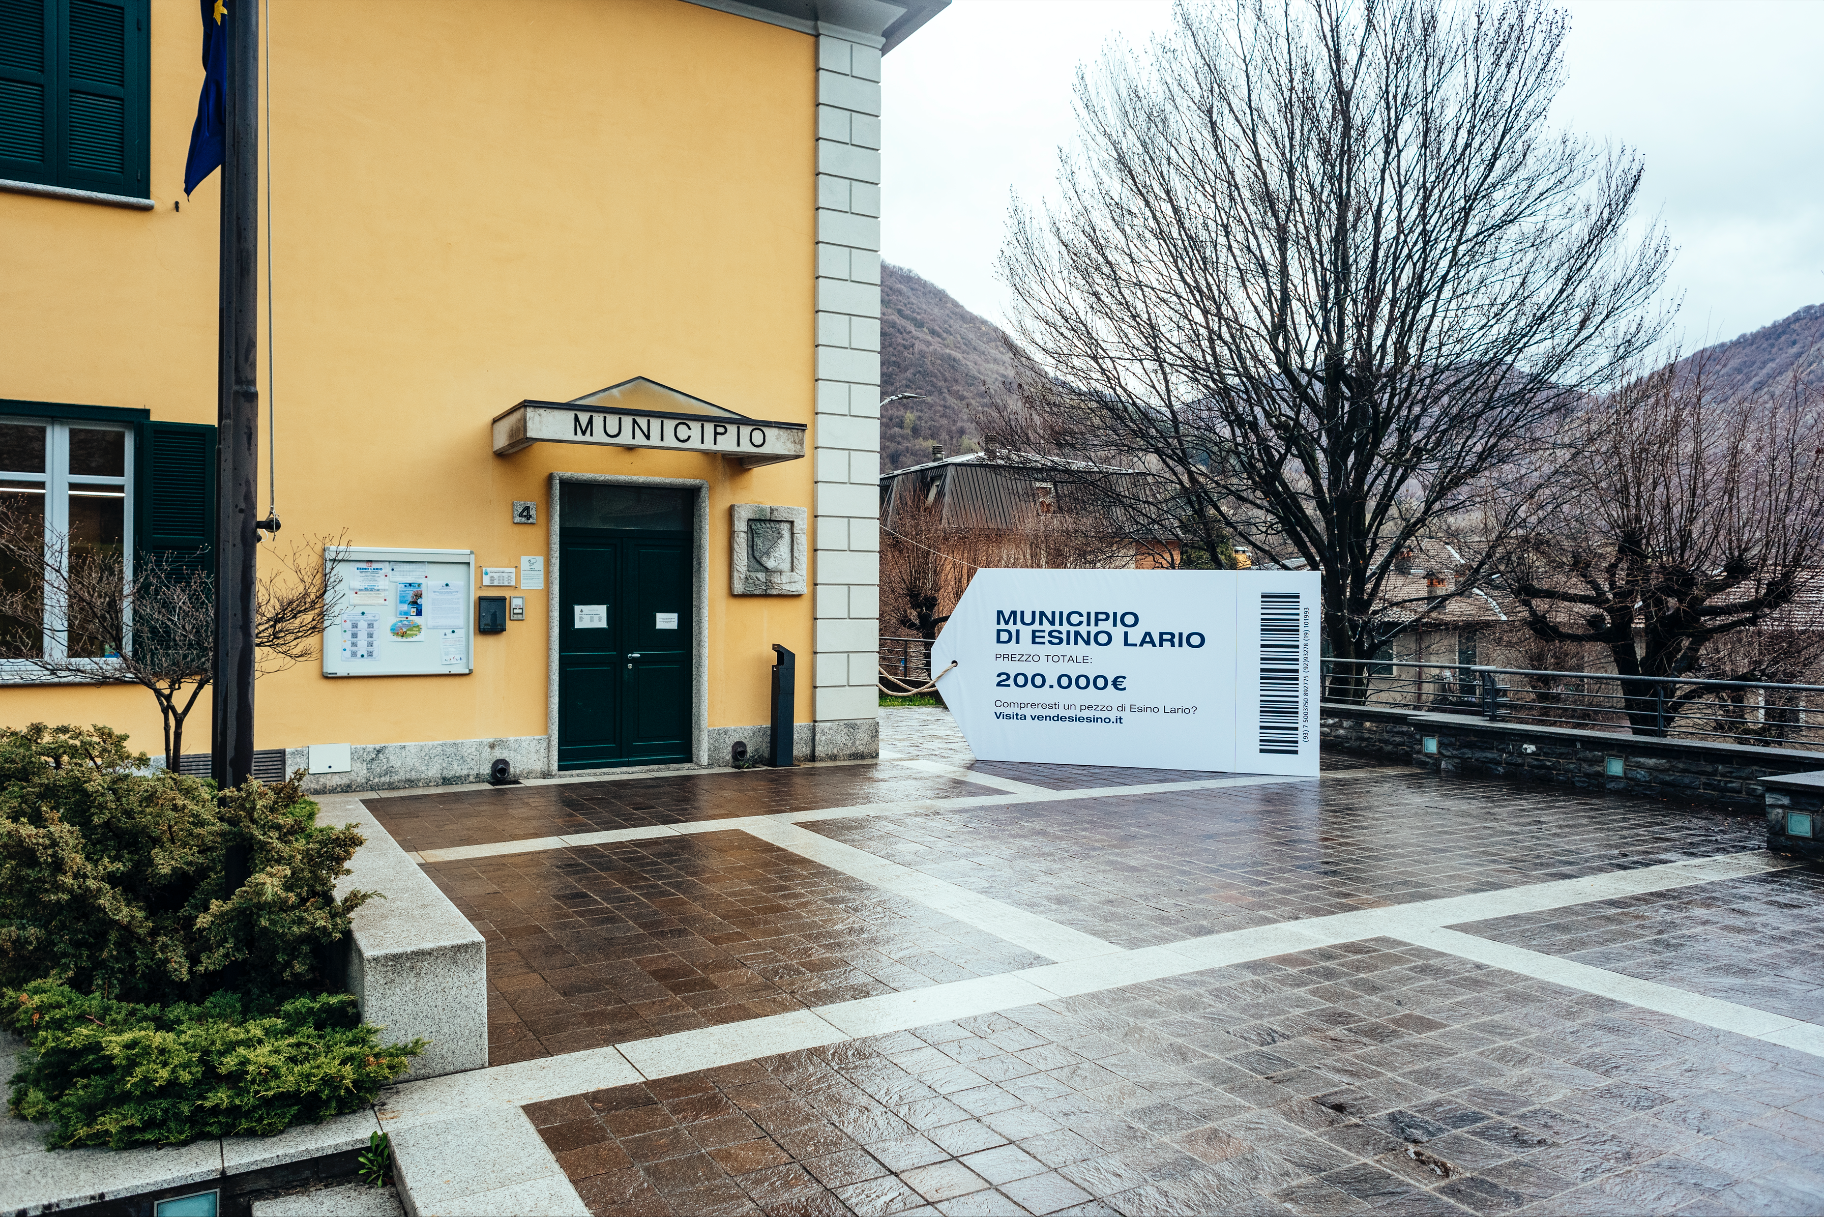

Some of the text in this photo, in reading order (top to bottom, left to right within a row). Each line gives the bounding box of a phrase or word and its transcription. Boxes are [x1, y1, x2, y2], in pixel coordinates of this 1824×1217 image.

[573, 412, 767, 449] MUNICIPIO
[518, 505, 533, 521] 4
[996, 609, 1140, 628] MUNICIPIO
[996, 628, 1206, 649] DI ESINO LARIO
[995, 653, 1093, 664] PREZZO TOTALE:
[995, 671, 1127, 692] 200.000€
[1063, 703, 1077, 711] un
[1079, 703, 1113, 713] pezzo
[1116, 703, 1126, 712] di
[1129, 704, 1160, 714] Esino
[1163, 705, 1198, 715] Lario?
[994, 711, 1124, 725] Visita vendesiesino.it
